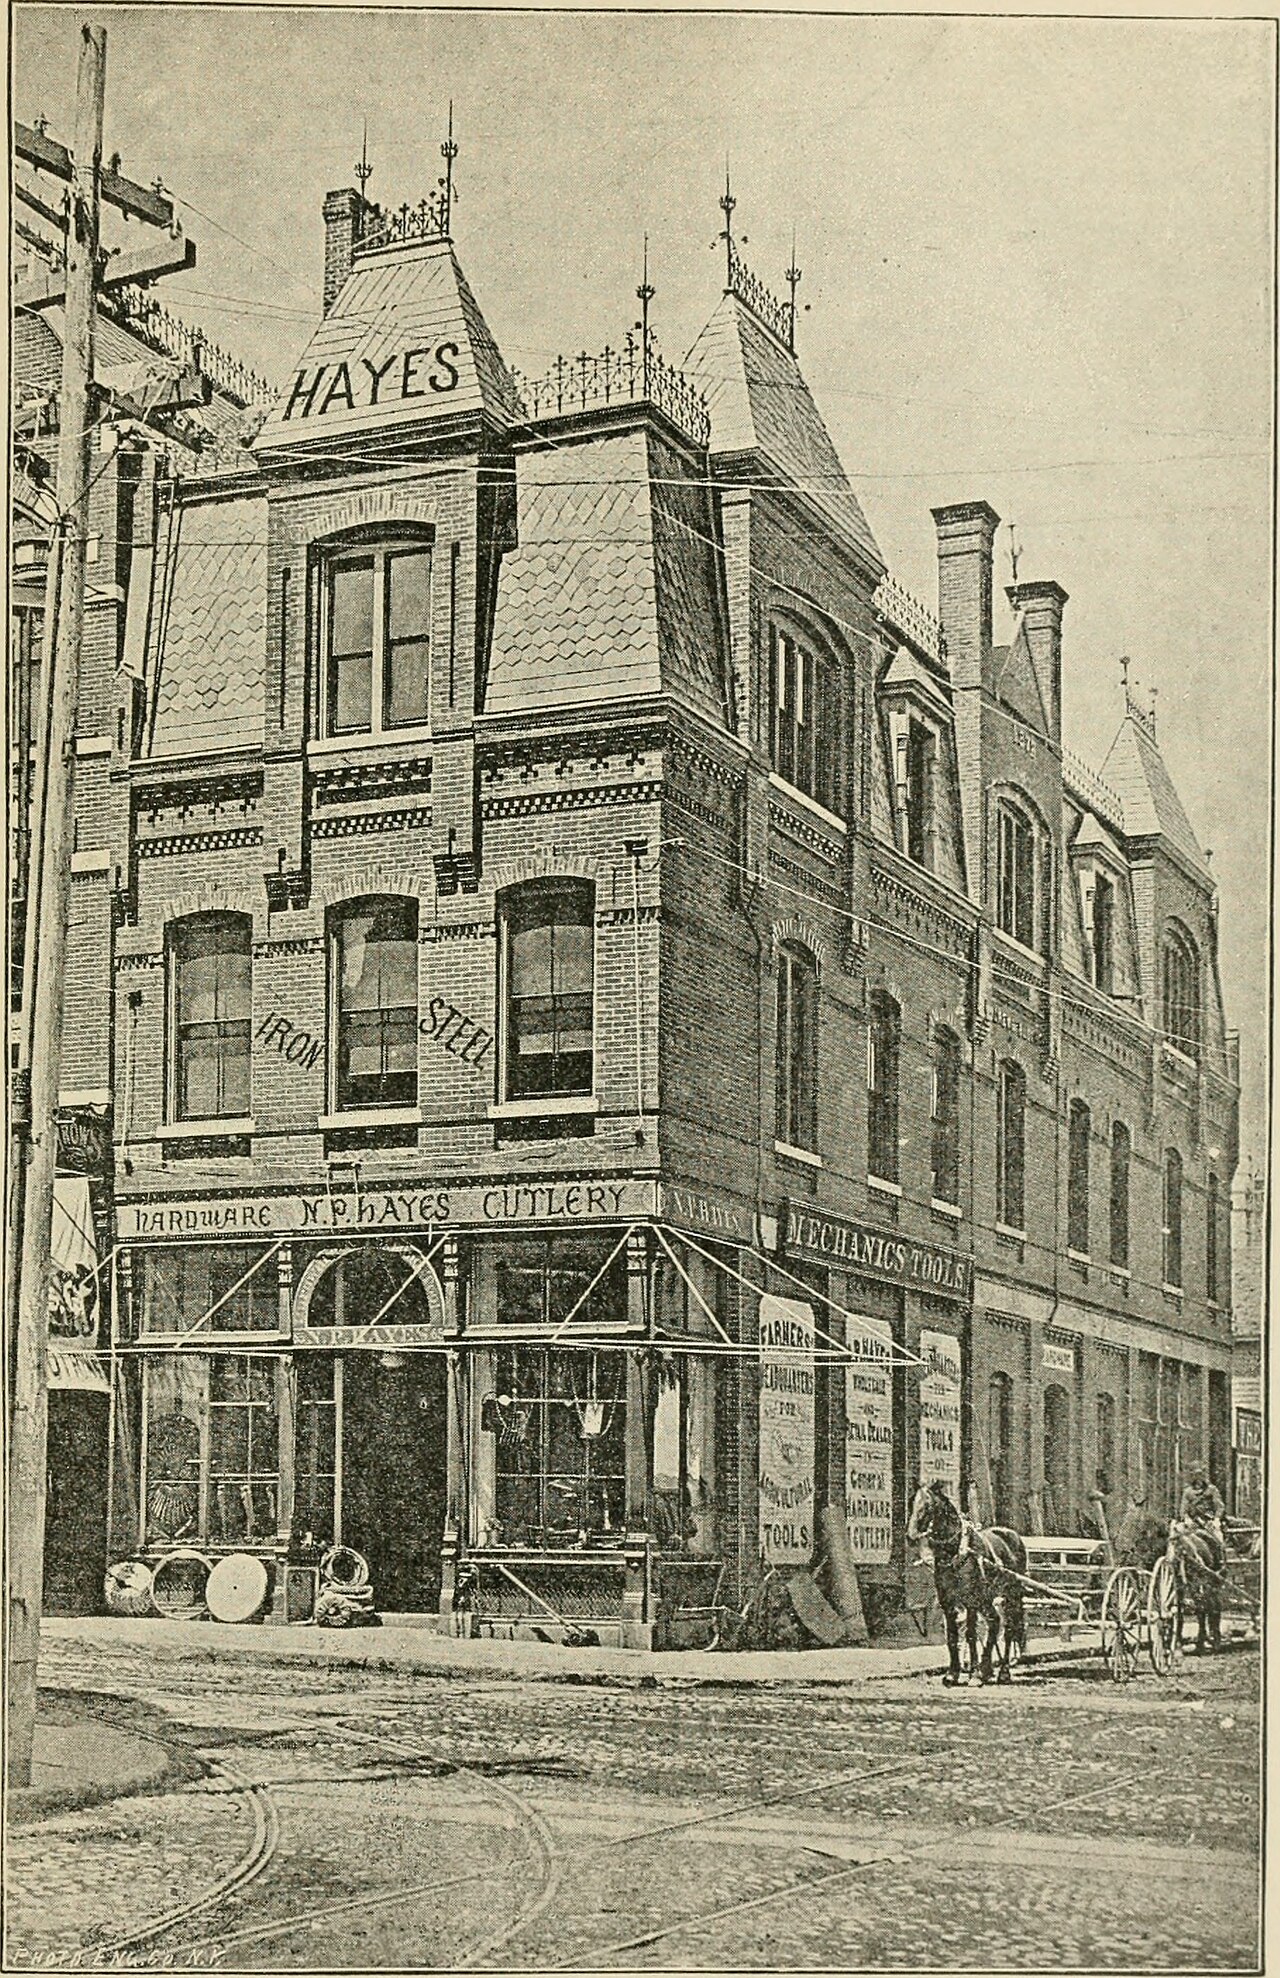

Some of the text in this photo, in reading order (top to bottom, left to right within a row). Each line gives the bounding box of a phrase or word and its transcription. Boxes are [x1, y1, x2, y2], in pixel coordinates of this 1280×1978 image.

[282, 342, 459, 421] HAYES
[254, 1011, 323, 1072] IRON
[418, 997, 495, 1071] STEEL
[483, 1185, 626, 1219] CUTLERY
[787, 1203, 966, 1289] MECHANICS TOOLS
[920, 1401, 956, 1422] ECHANICS
